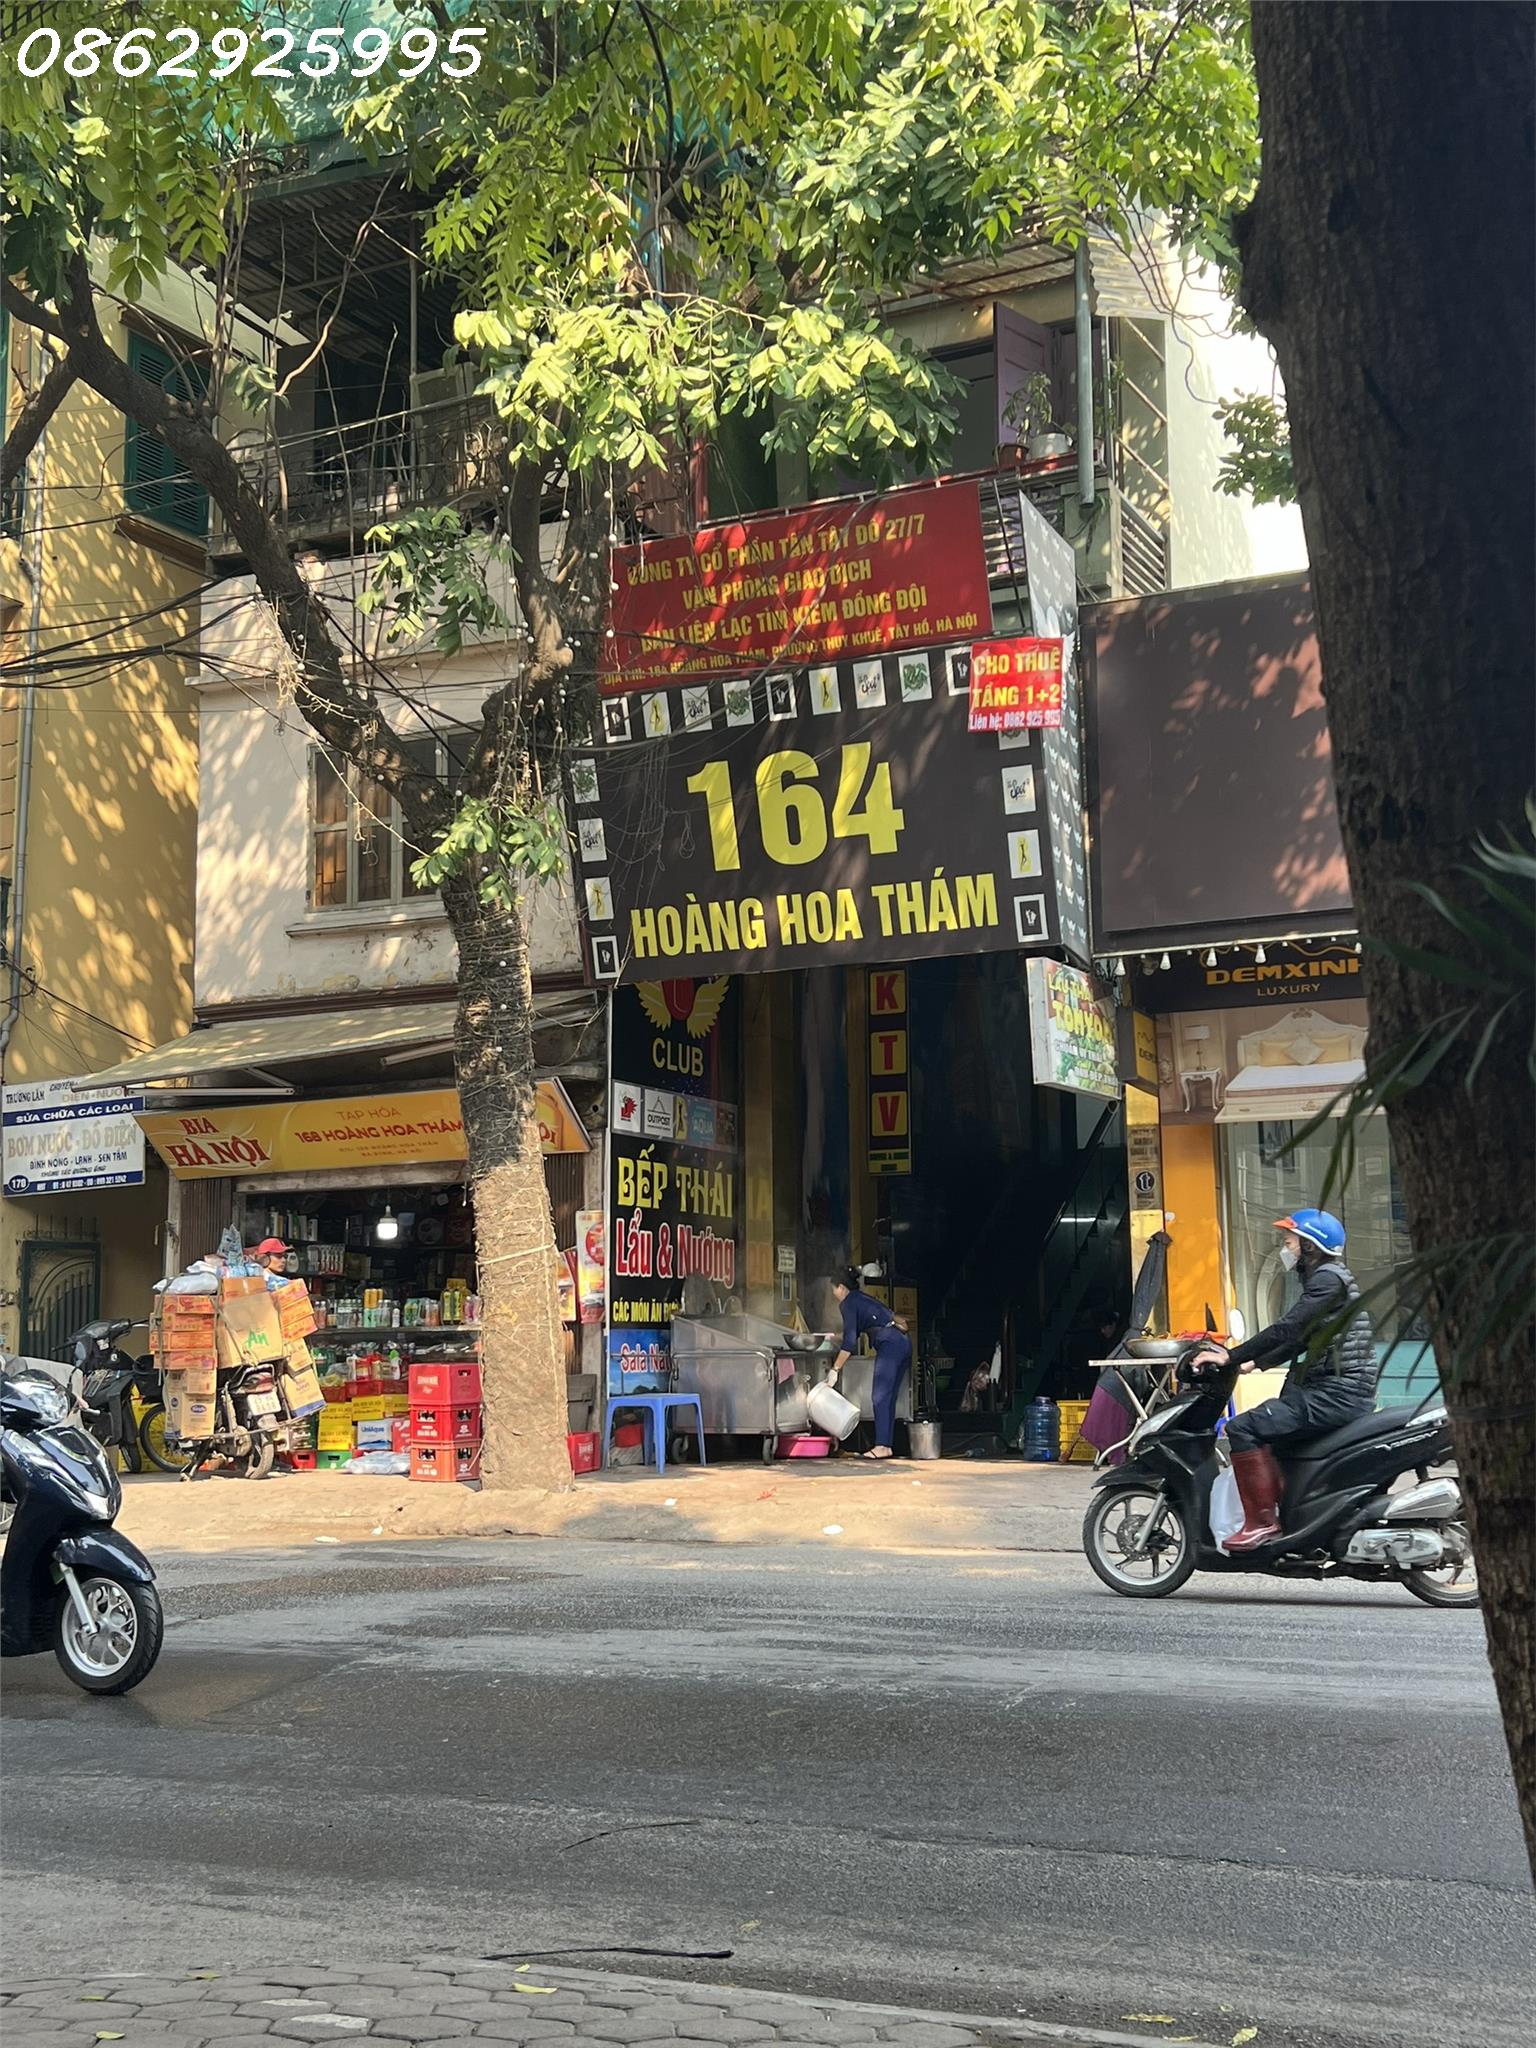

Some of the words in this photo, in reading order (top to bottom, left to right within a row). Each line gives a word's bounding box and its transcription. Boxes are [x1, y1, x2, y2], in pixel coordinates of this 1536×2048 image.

[701, 543, 723, 572] CỔ
[855, 519, 881, 546] ĐÔ
[885, 514, 926, 541] 27/7
[721, 574, 780, 604] PHÒNG
[784, 567, 825, 594] GIAO
[721, 614, 753, 642] LẠC
[756, 607, 788, 633] TÌM
[896, 583, 928, 612] ĐỘI
[710, 654, 732, 668] HOA
[936, 616, 953, 632] HÀ
[956, 612, 978, 629] NỘI
[973, 654, 1010, 676] CHO
[1015, 646, 1060, 673] THUÊ
[1026, 683, 1061, 704] 1+2
[970, 712, 987, 730] Liên
[687, 742, 905, 872] 164
[630, 888, 768, 959] HOÀNG
[777, 888, 865, 946] HOA
[872, 866, 999, 937] THÁM
[1257, 983, 1321, 997] LUXURY
[652, 1037, 704, 1077] CLUB
[16, 1111, 40, 1123] SỬA
[43, 1108, 75, 1121] CHỮA
[78, 1105, 102, 1117] CÁC
[106, 1103, 133, 1113] LOẠI
[178, 1117, 219, 1136] BIA
[648, 1113, 671, 1127] OUTPOST
[294, 1131, 322, 1144] 168
[323, 1125, 380, 1142] HOÀNG
[380, 1124, 418, 1138] HOA
[418, 1118, 464, 1133] THÁM
[98, 1153, 111, 1163] SEN
[166, 1138, 218, 1167] HÀ
[207, 1135, 271, 1167] NỘI
[12, 1178, 26, 1189] 170
[617, 1143, 668, 1209] BẾP
[675, 1161, 733, 1218] THÁI
[616, 1207, 652, 1277] Lẩu
[657, 1222, 673, 1278] &
[677, 1224, 735, 1289] Nướng
[613, 1297, 629, 1322] CÁC
[630, 1297, 649, 1322] MÓN
[650, 1298, 662, 1322] ĂN
[621, 1343, 648, 1373] Sala
